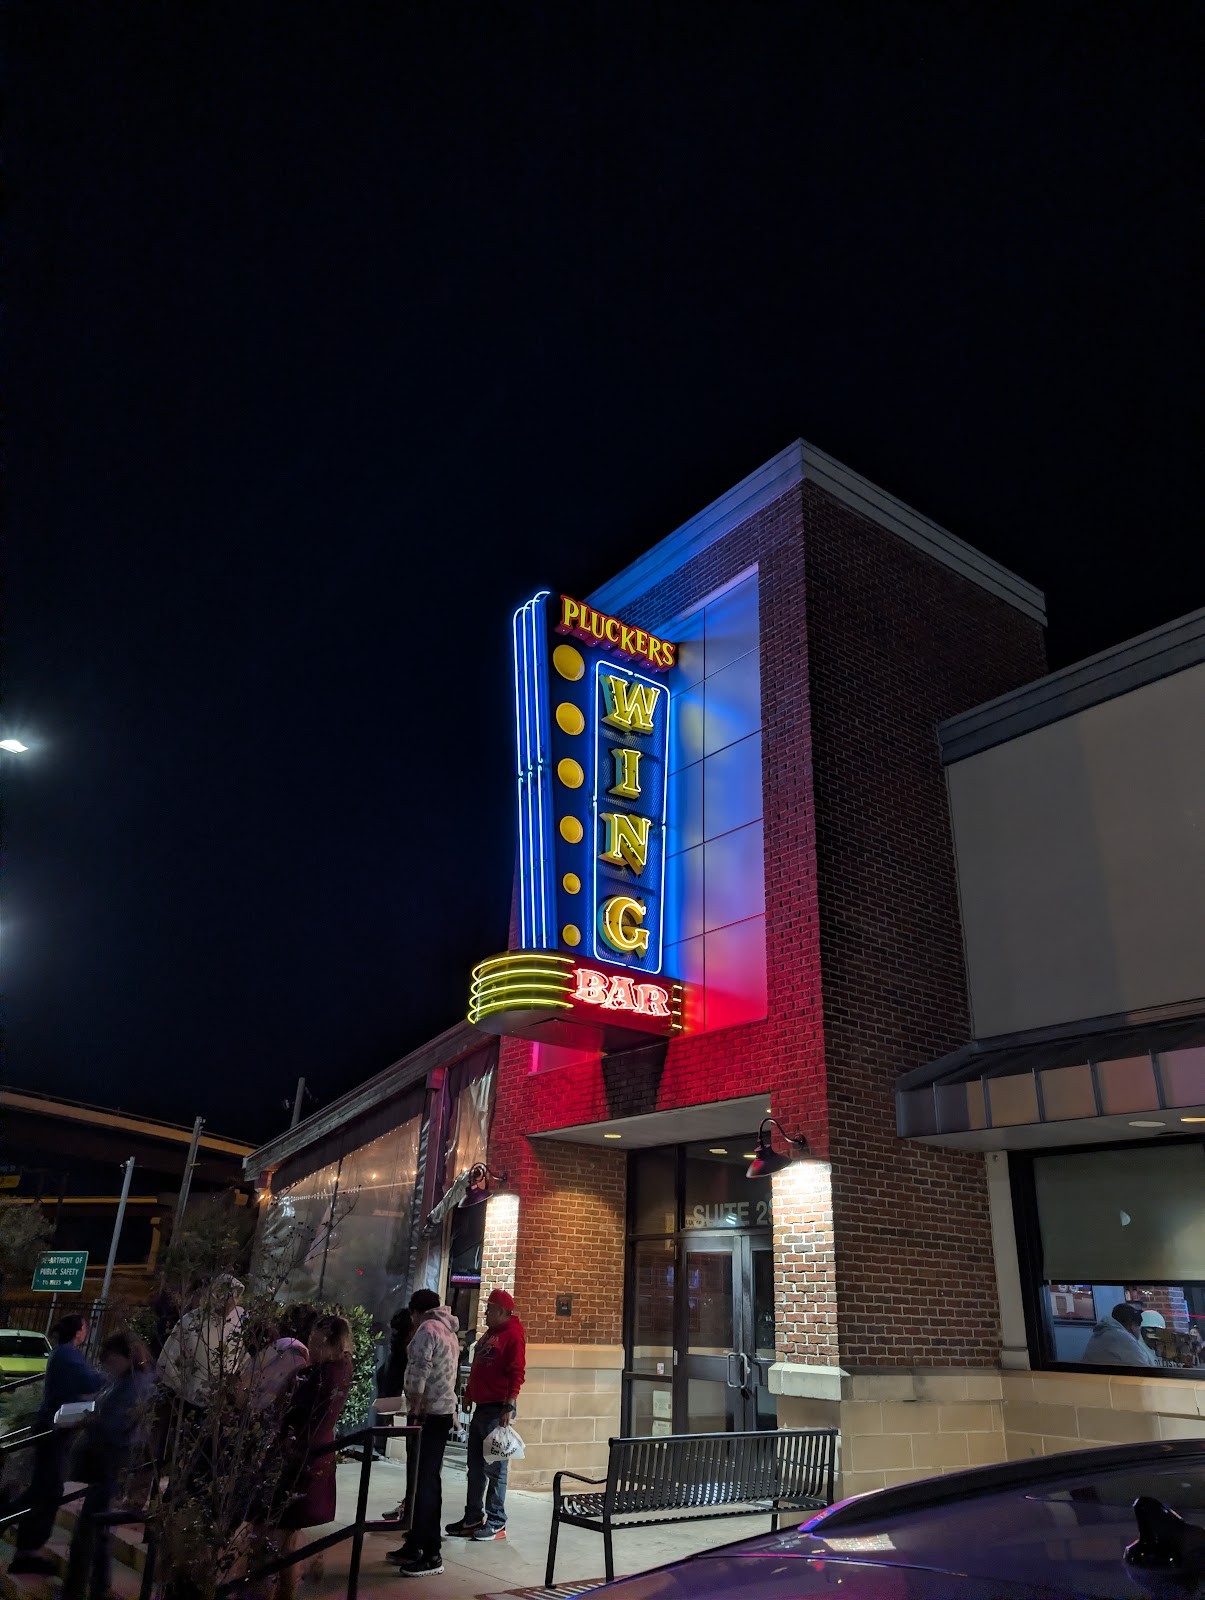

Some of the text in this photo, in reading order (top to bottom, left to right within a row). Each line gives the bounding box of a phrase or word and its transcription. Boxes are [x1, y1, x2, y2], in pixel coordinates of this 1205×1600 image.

[562, 597, 675, 667] PLUCKERS
[600, 674, 661, 957] WING
[571, 968, 671, 1016] BAR
[693, 1202, 750, 1228] SUITE
[40, 1268, 79, 1276] PUBLIC SAFETY
